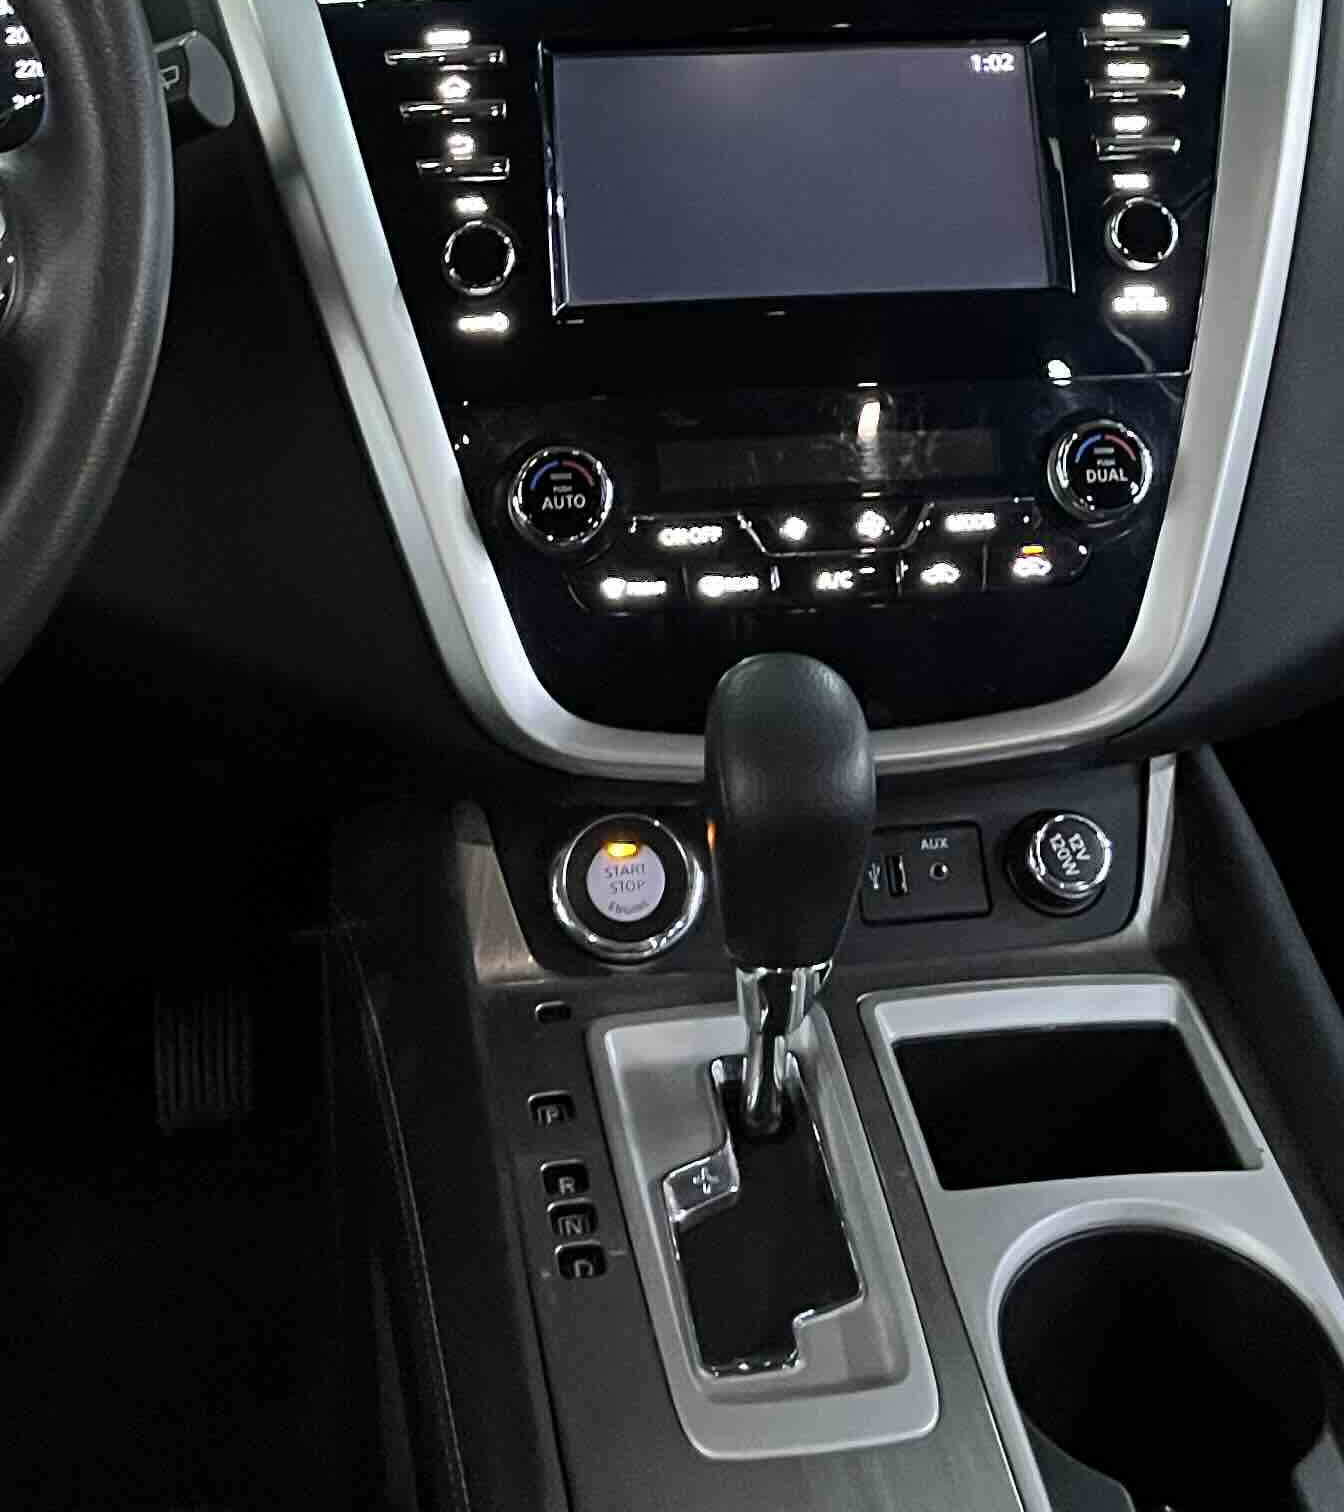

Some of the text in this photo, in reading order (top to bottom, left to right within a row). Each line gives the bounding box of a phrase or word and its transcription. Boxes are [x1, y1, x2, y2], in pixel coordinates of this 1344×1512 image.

[970, 52, 1016, 72] 1:02
[1086, 467, 1129, 484] DUAL
[542, 493, 587, 511] AUTO
[920, 838, 949, 851] AUX
[602, 863, 646, 879] START
[608, 879, 646, 895] STOP
[558, 1175, 577, 1195] R
